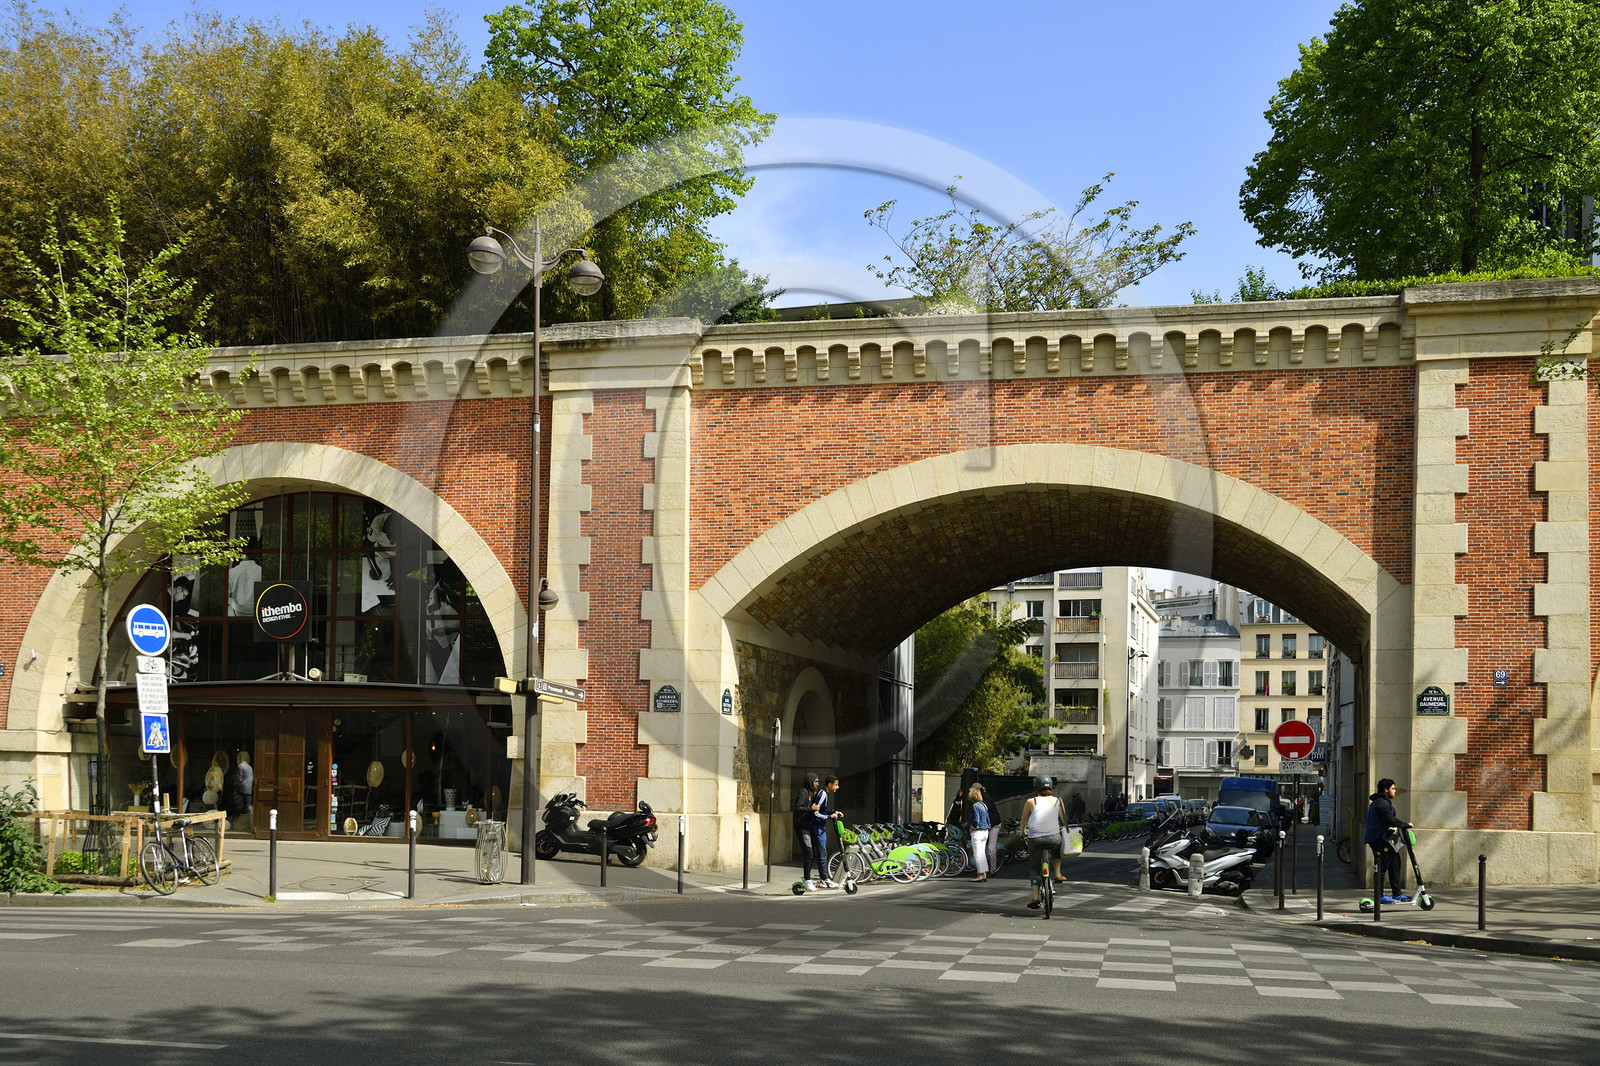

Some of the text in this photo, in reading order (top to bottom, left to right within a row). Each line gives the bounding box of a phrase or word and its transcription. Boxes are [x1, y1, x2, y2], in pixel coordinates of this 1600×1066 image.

[261, 602, 302, 617] ithemba
[262, 615, 278, 623] DESIGN
[1495, 670, 1506, 679] 69
